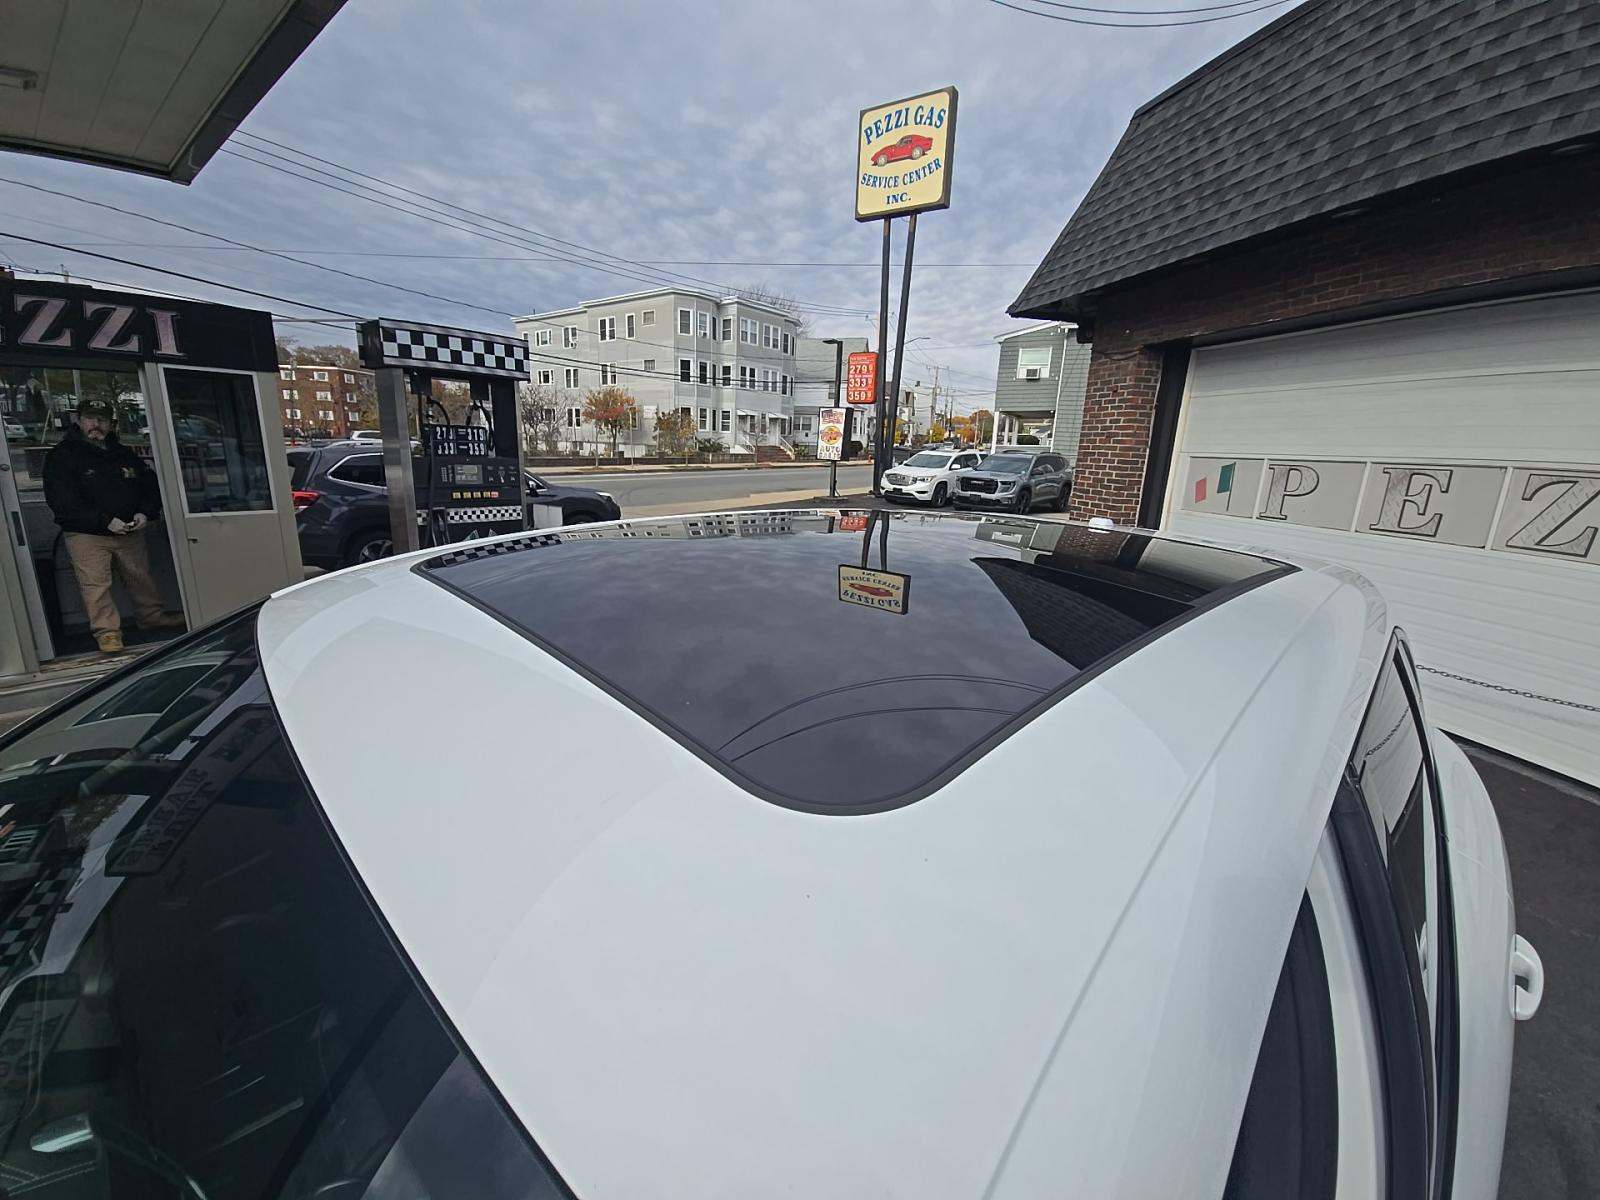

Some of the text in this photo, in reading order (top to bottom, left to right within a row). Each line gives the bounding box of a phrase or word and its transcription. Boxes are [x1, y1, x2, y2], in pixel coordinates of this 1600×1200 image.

[863, 105, 947, 145] PEZZI GAS
[860, 157, 942, 189] SERVICE CENTER
[886, 192, 912, 205] INC.
[0, 294, 187, 358] ZZI
[849, 364, 868, 374] 279
[848, 377, 867, 388] 333
[847, 390, 866, 401] 359
